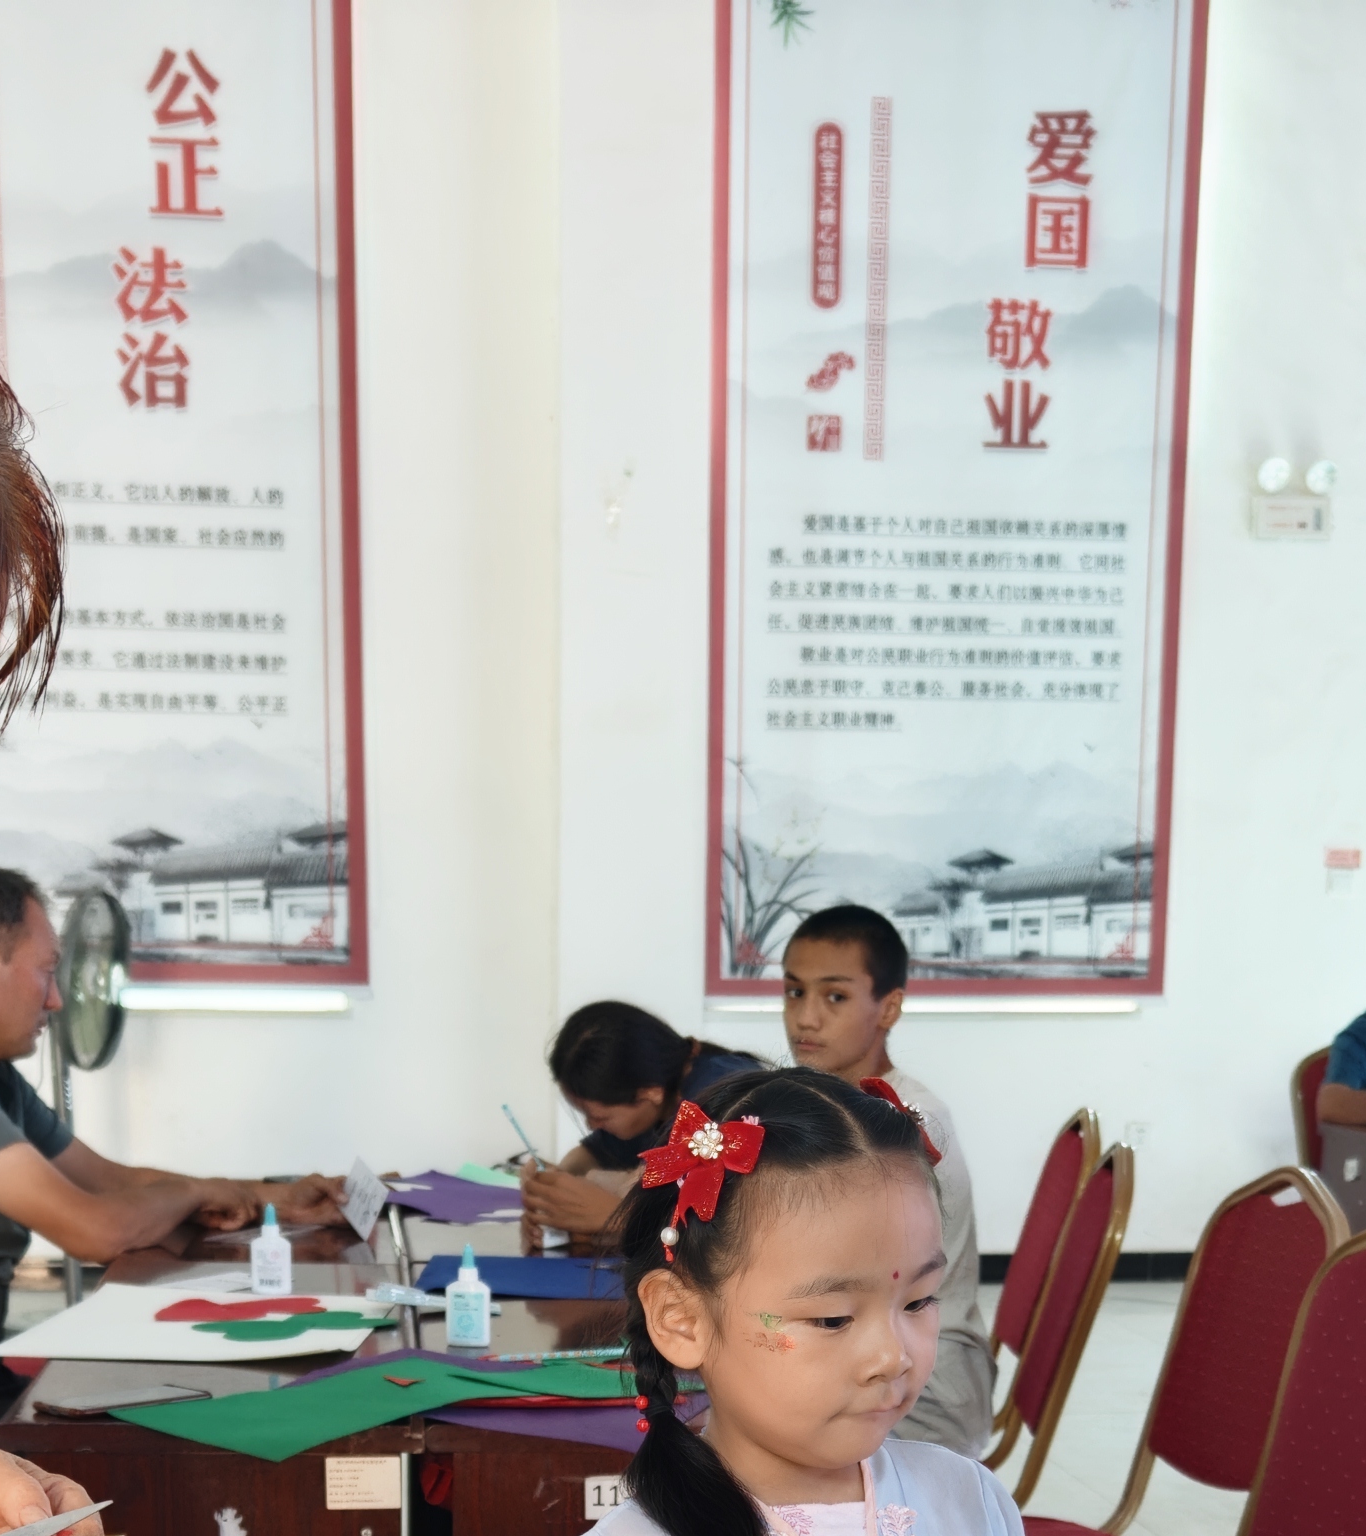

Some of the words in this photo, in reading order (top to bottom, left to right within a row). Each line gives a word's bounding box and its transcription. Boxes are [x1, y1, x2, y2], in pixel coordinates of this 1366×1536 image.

[147, 47, 225, 220] 公正
[1025, 109, 1097, 271] 爱国
[113, 247, 189, 410] 法治
[983, 298, 1053, 451] 敬业
